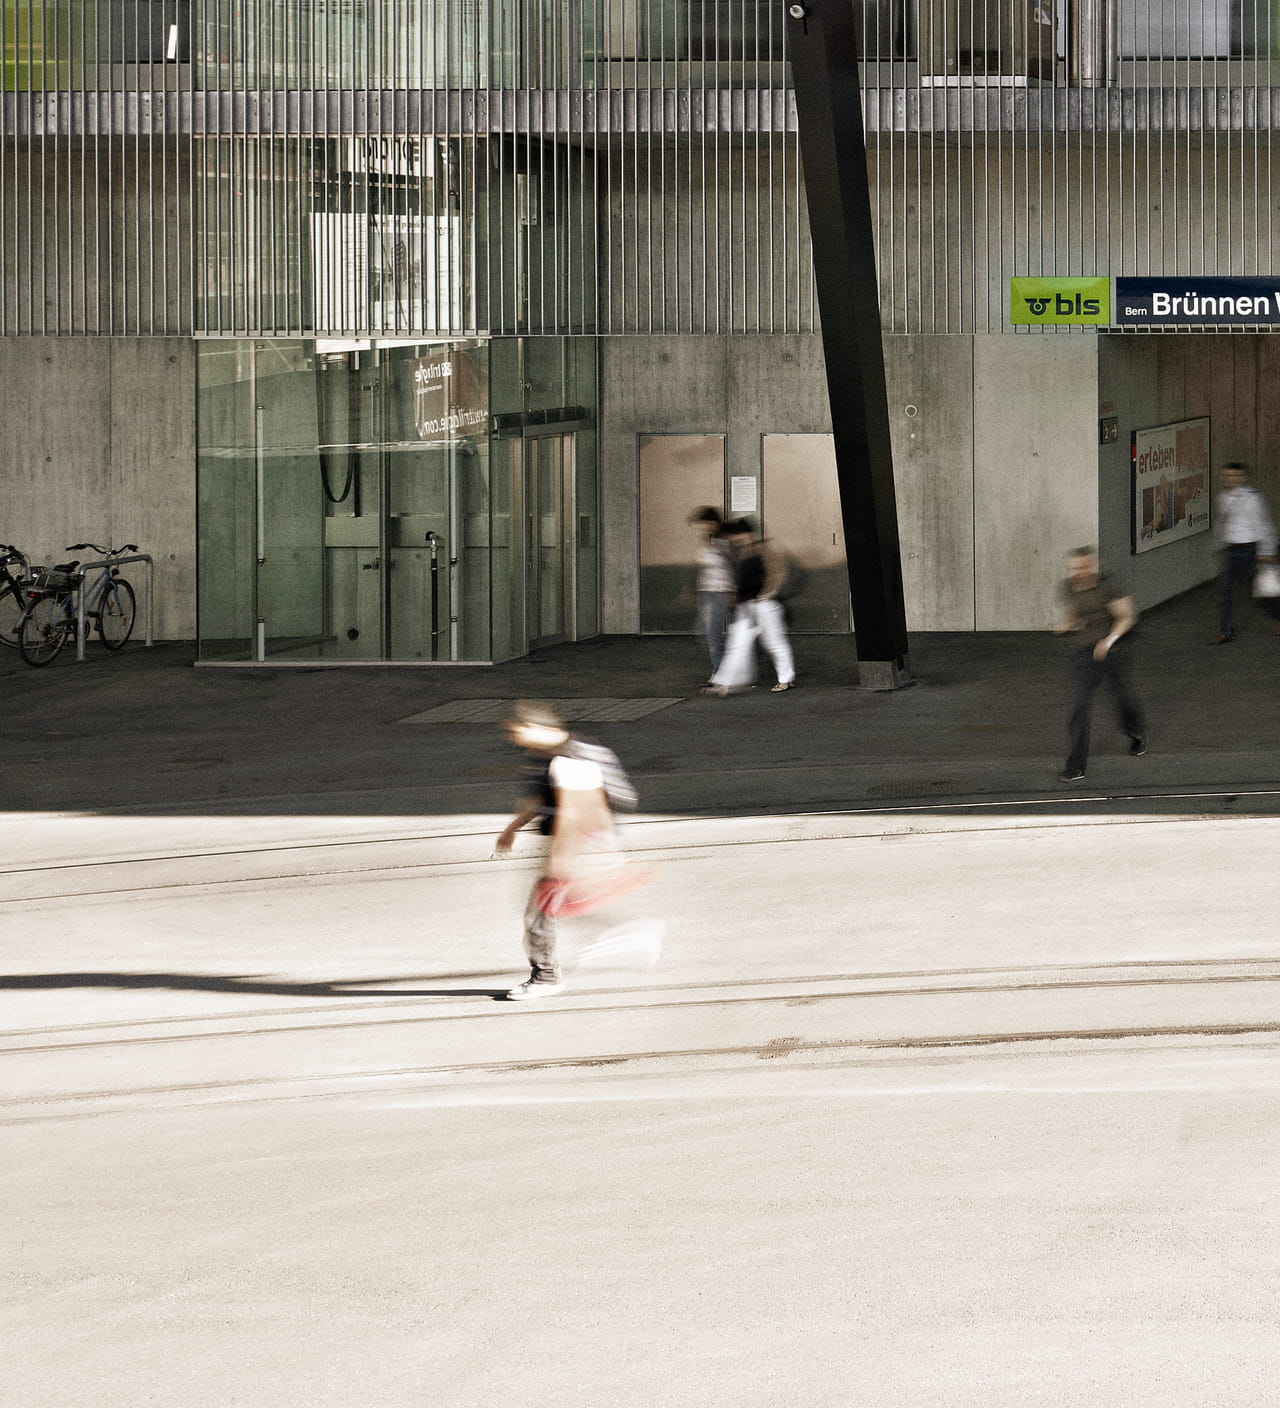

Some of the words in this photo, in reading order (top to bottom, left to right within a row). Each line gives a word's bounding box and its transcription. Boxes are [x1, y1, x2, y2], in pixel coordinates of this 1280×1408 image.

[1055, 292, 1100, 316] bls
[1125, 307, 1148, 316] Bern
[1152, 292, 1270, 315] Brünnen
[1138, 444, 1176, 475] erleben
